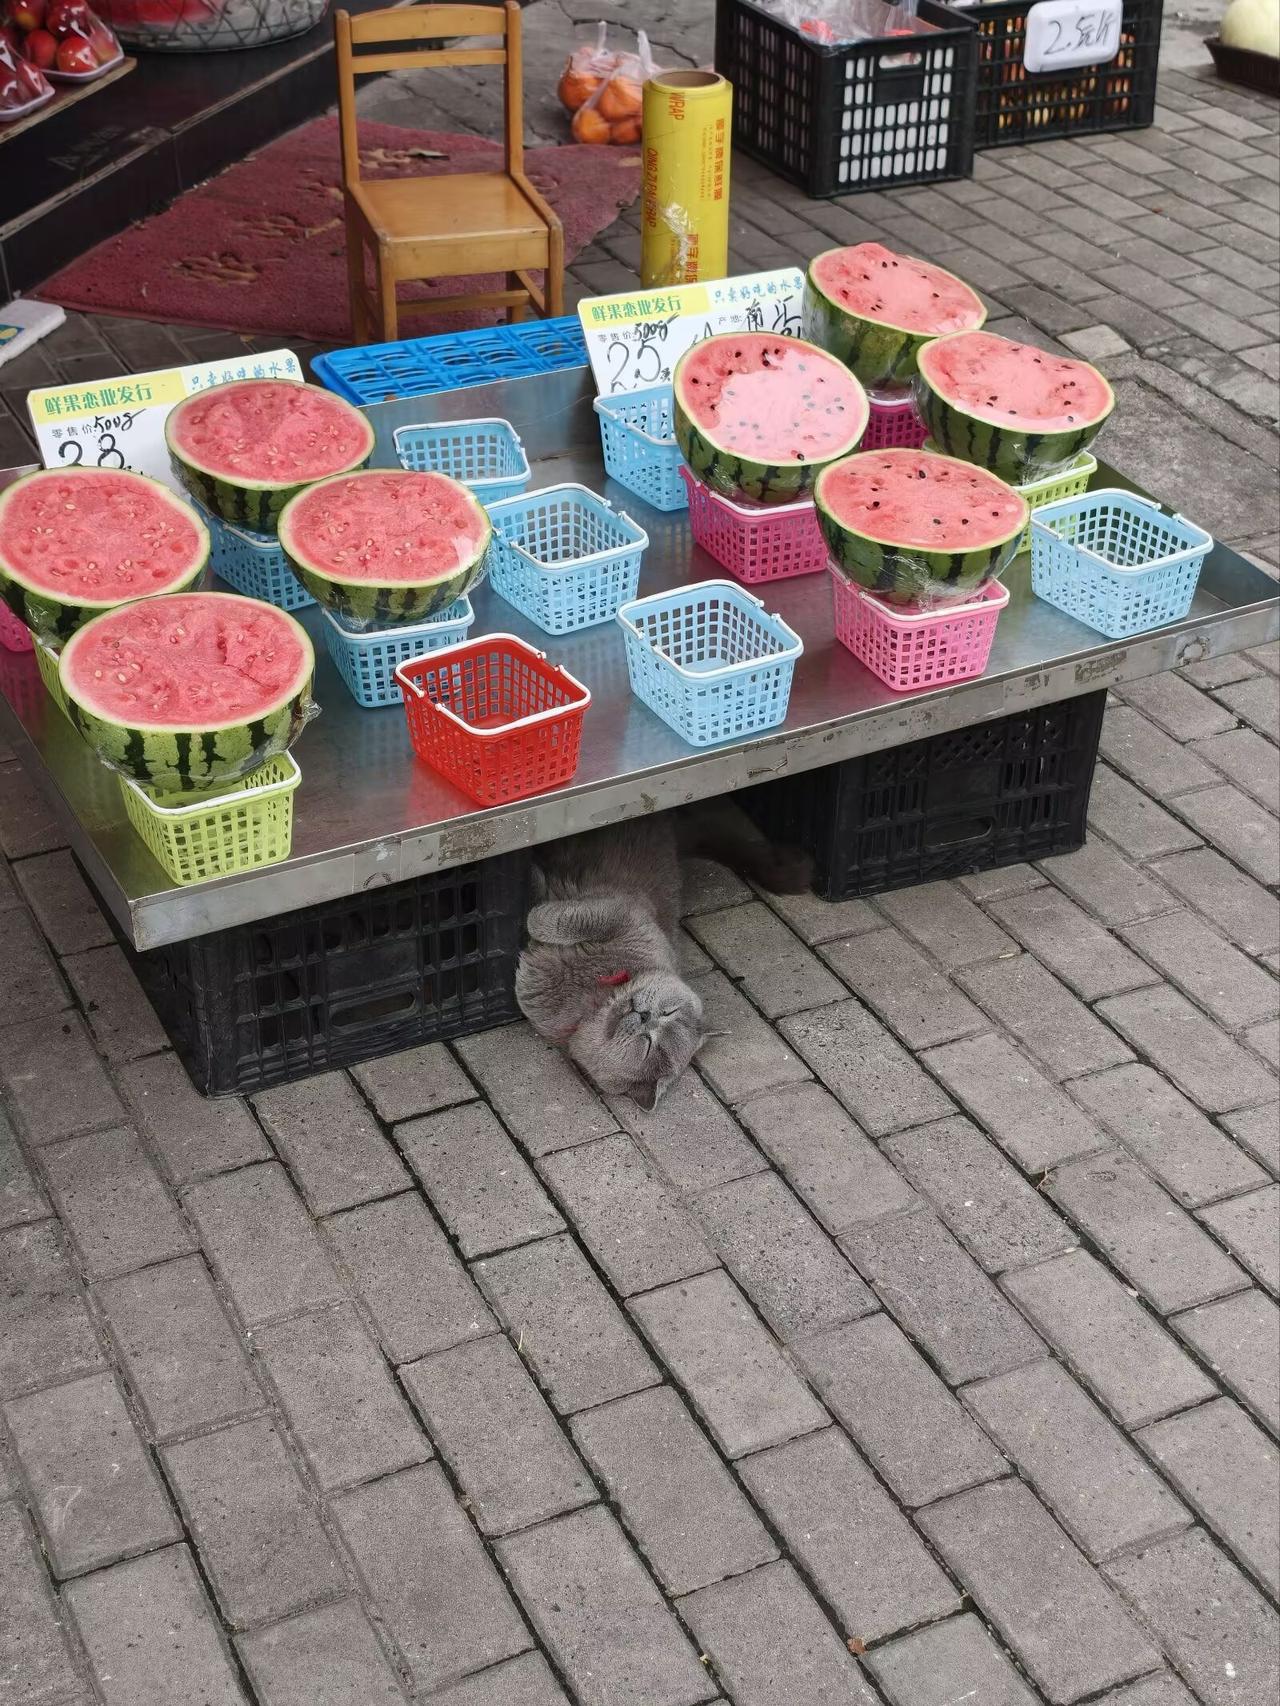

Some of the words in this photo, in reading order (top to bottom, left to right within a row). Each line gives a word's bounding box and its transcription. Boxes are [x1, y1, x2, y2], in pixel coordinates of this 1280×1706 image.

[591, 295, 682, 322] 鲜果恋批发行
[714, 275, 803, 304] 只卖好吃的水果
[44, 382, 153, 416] 鲜果恋批发行
